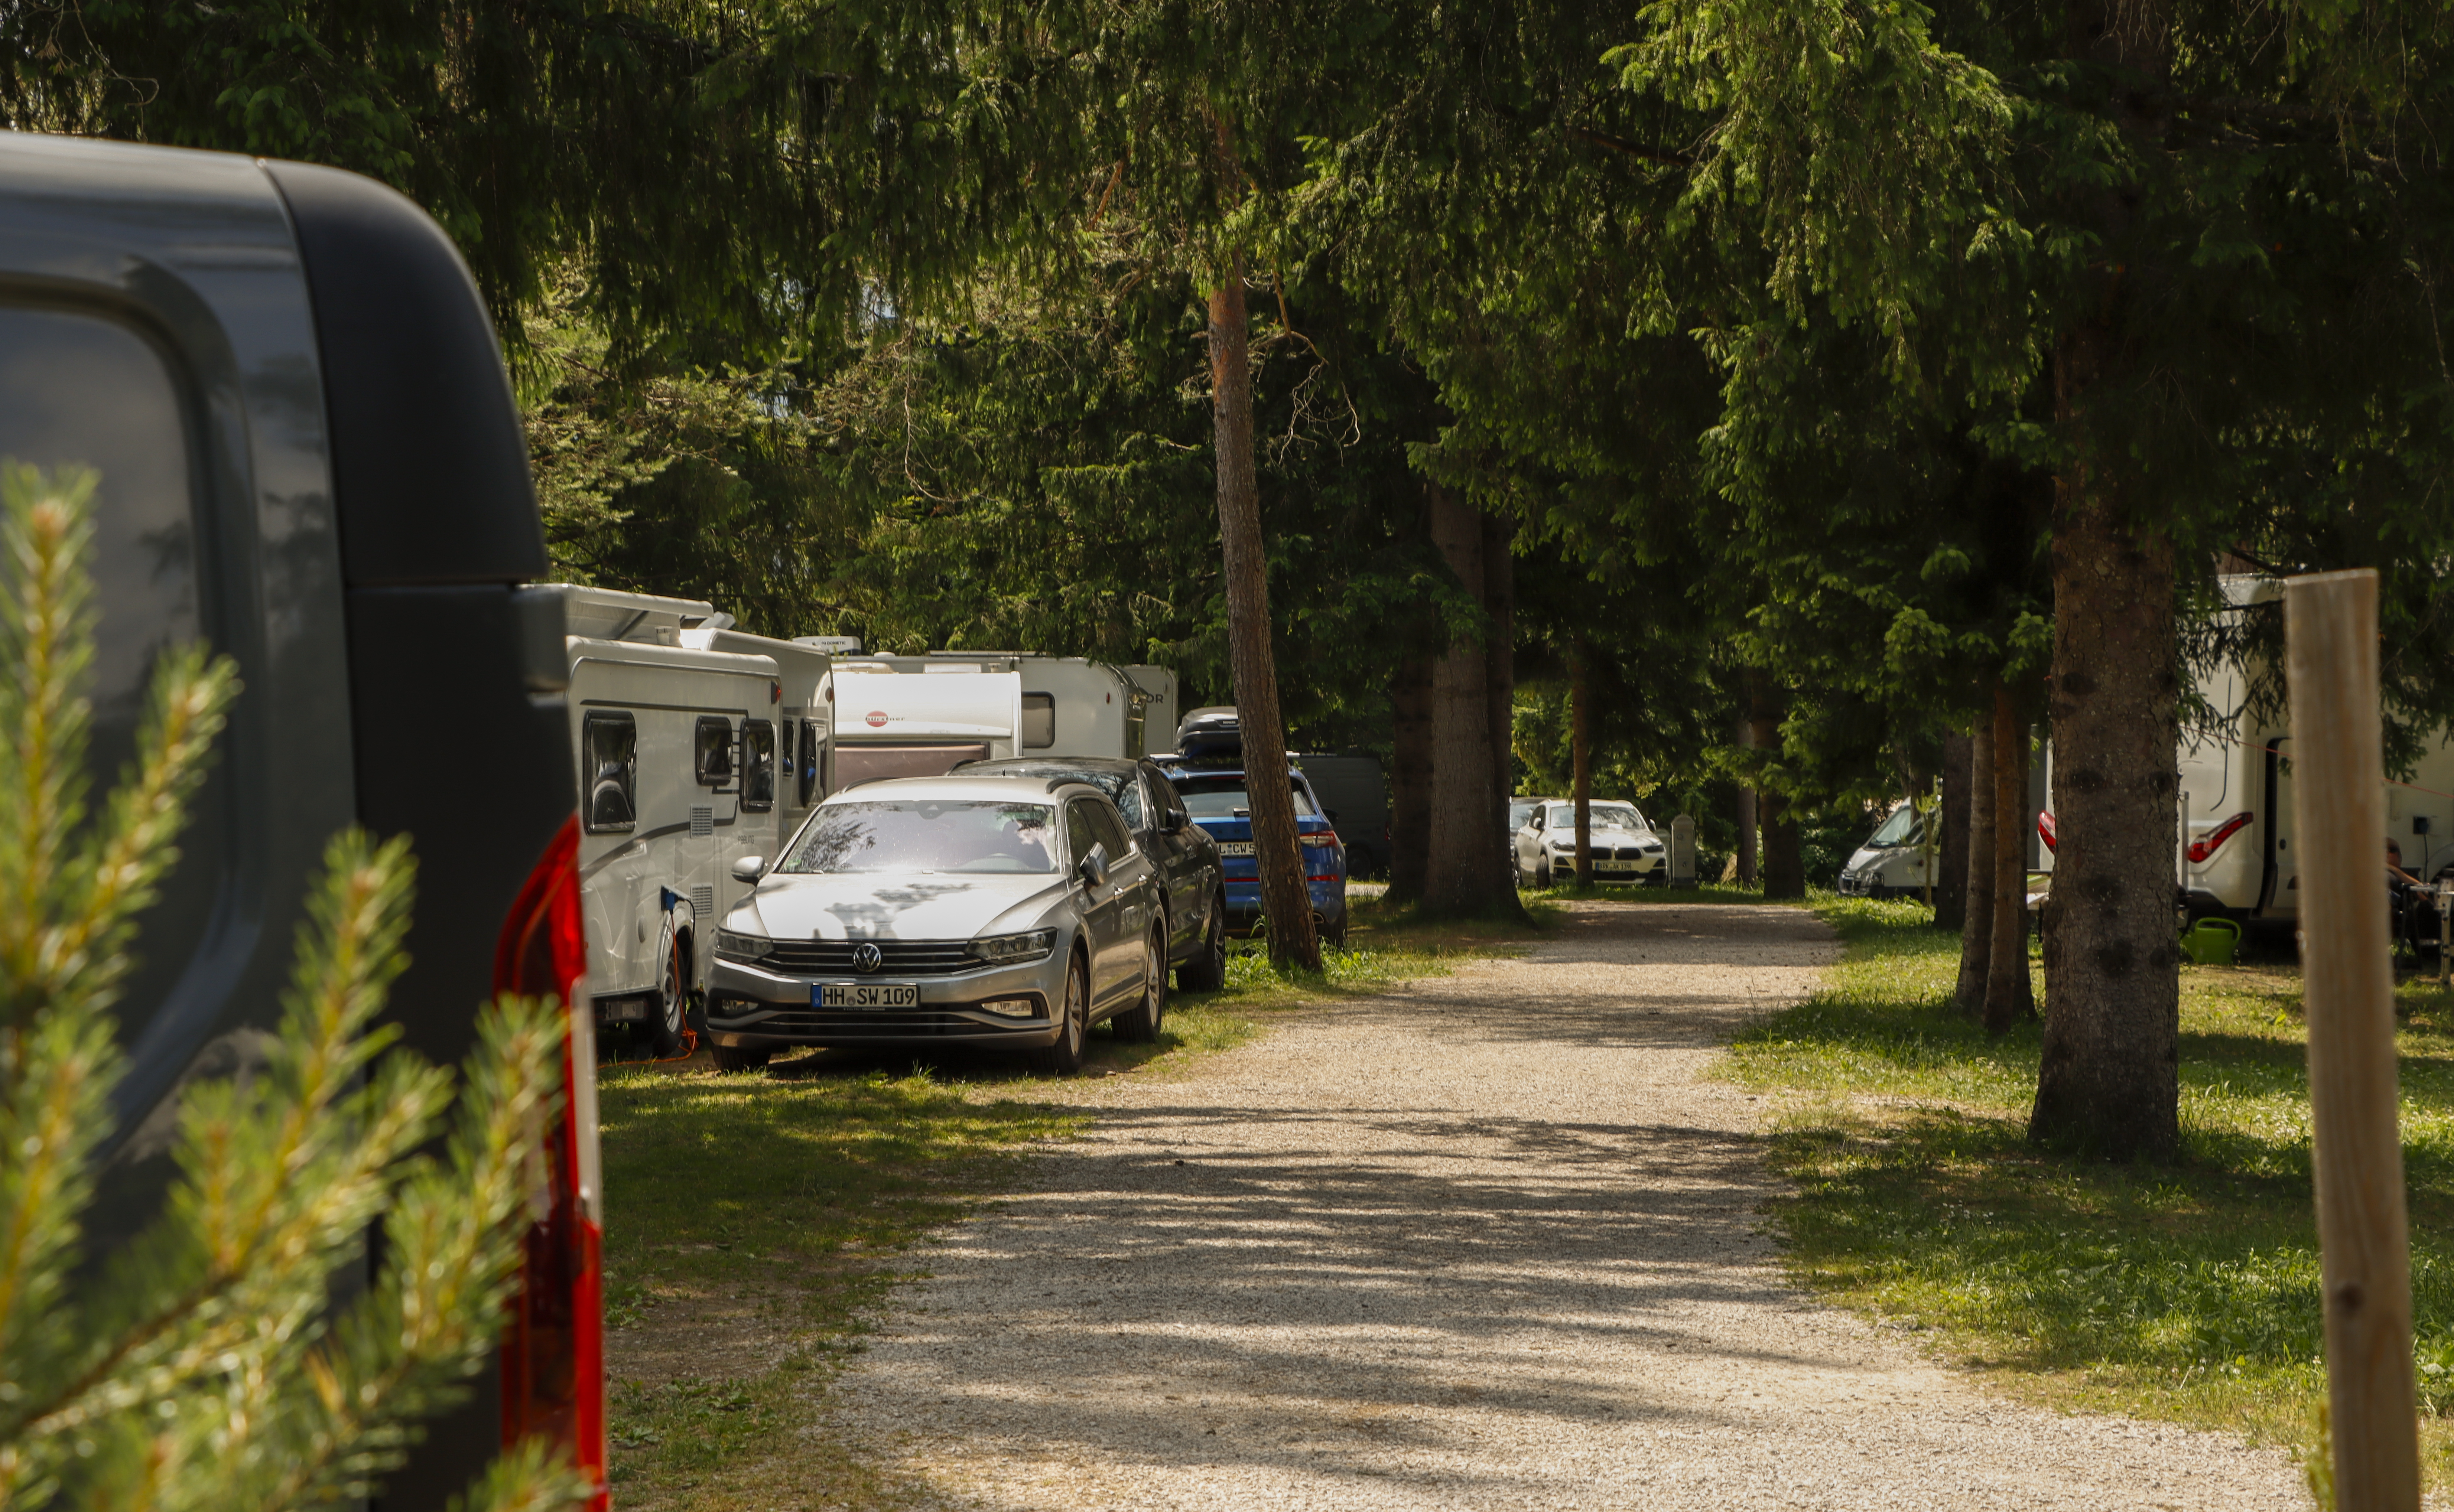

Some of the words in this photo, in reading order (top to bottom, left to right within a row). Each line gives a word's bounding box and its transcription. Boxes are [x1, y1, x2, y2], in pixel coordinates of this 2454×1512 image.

[1233, 844, 1246, 853] CW
[822, 988, 845, 1004] HH
[857, 988, 878, 1005] SW
[883, 988, 915, 1005] 109
